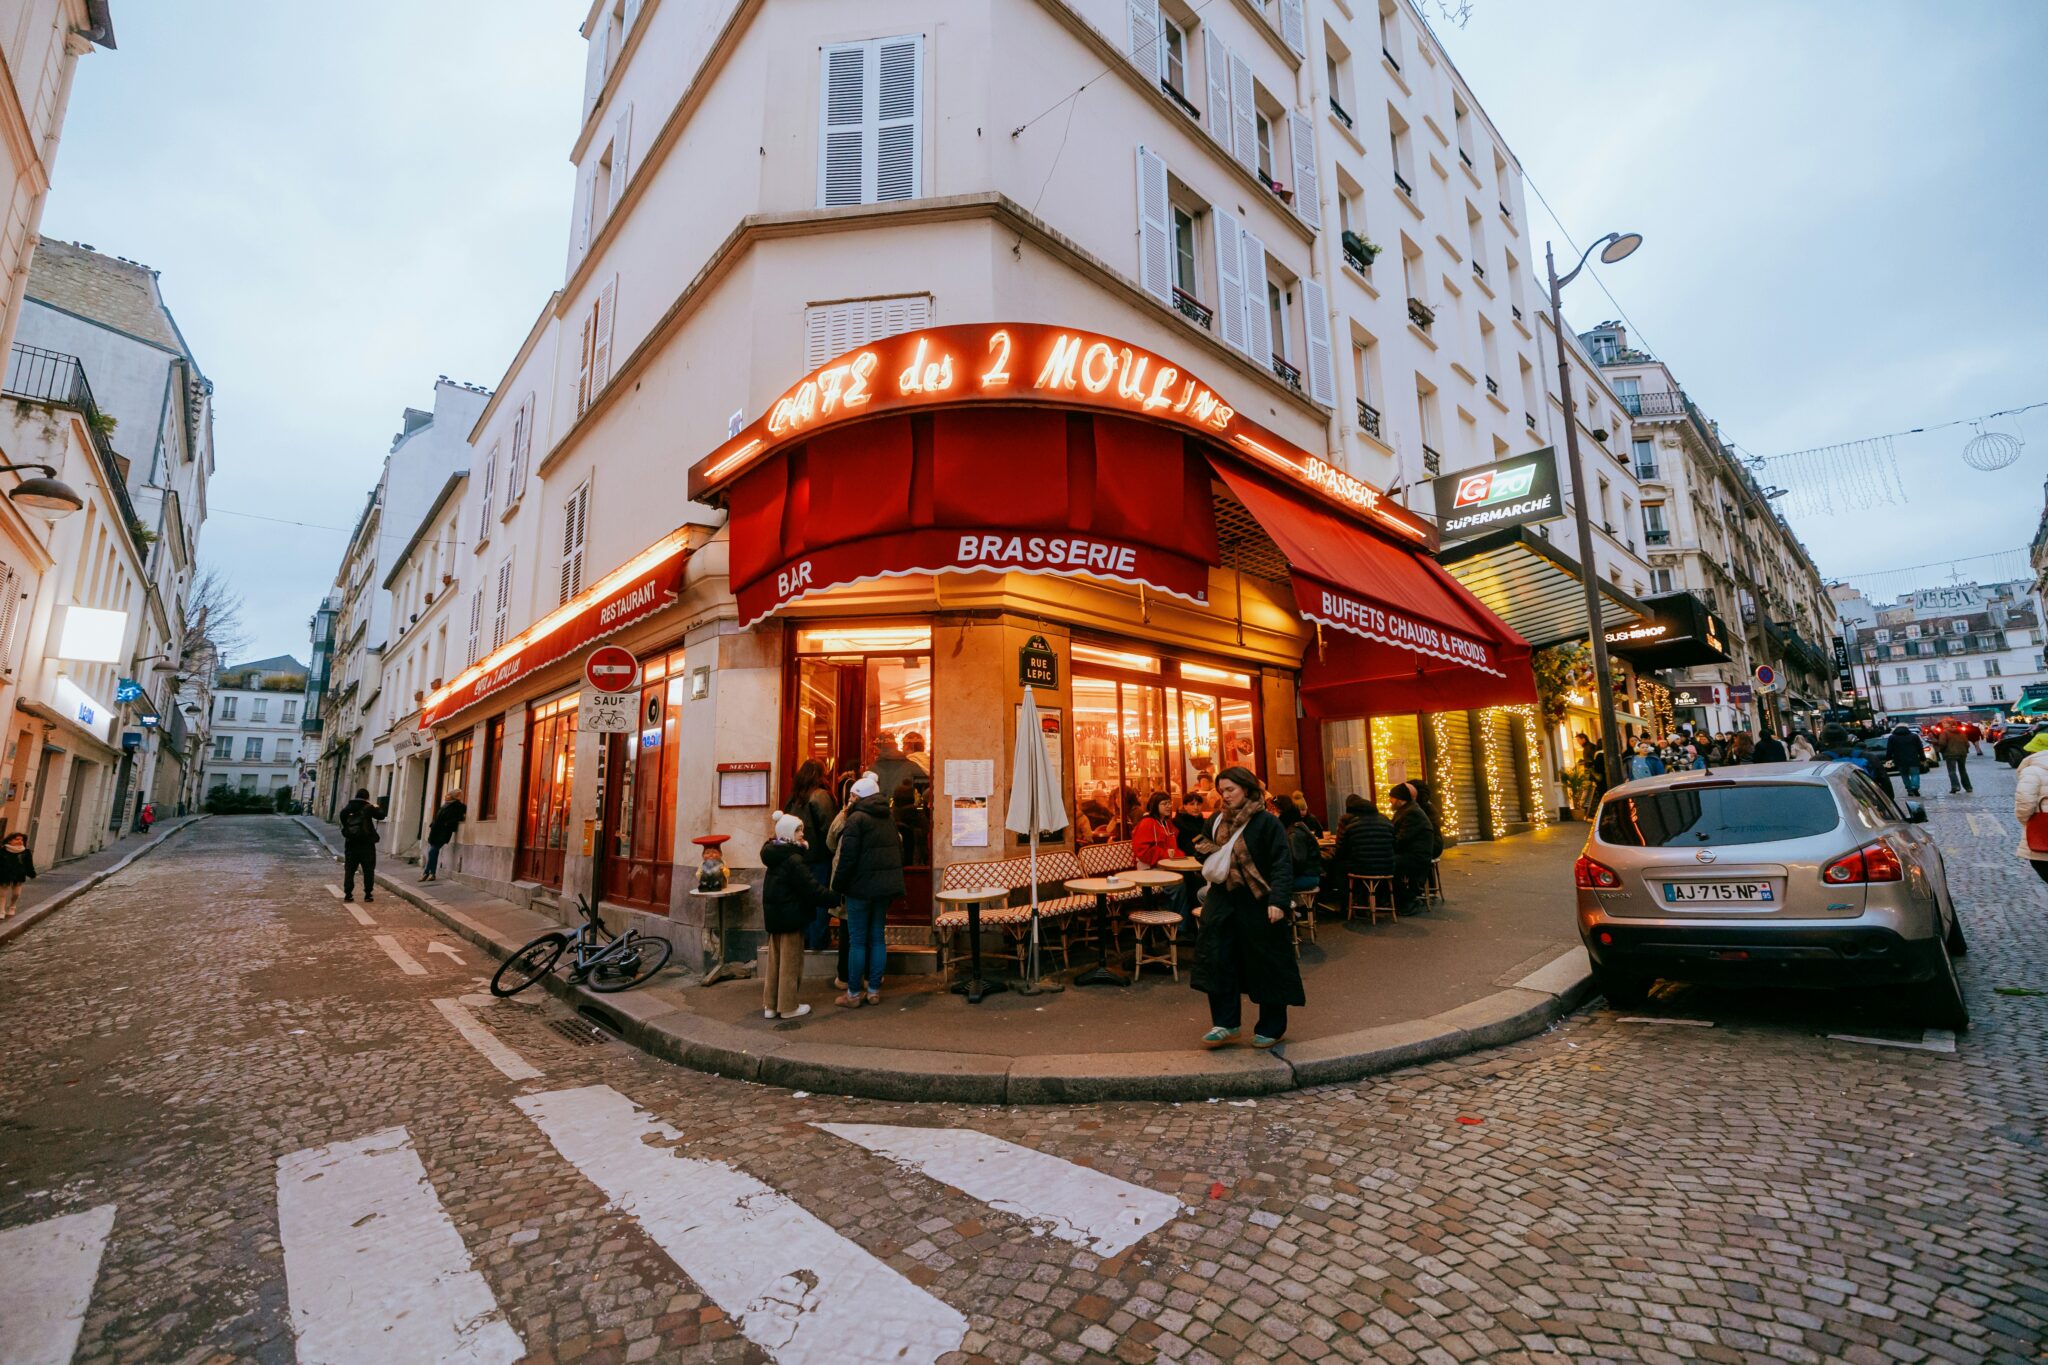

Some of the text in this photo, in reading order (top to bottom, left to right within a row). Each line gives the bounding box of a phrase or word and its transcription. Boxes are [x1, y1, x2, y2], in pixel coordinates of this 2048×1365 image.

[899, 337, 954, 396] des
[982, 330, 1012, 388] 2
[1034, 334, 1236, 432] MOULINS
[1306, 457, 1380, 512] BRASSERIE
[1445, 493, 1552, 532] SUPERMARCHÉ
[957, 535, 1136, 573] BRASSERIE
[777, 560, 812, 598] BAR
[600, 579, 656, 626] RESTAURANT
[1322, 591, 1487, 664] BUFFETS CHAUDS & FROIDS
[1027, 668, 1051, 681] LEPIC
[1030, 657, 1047, 669] RUE
[594, 696, 626, 706] SAUF
